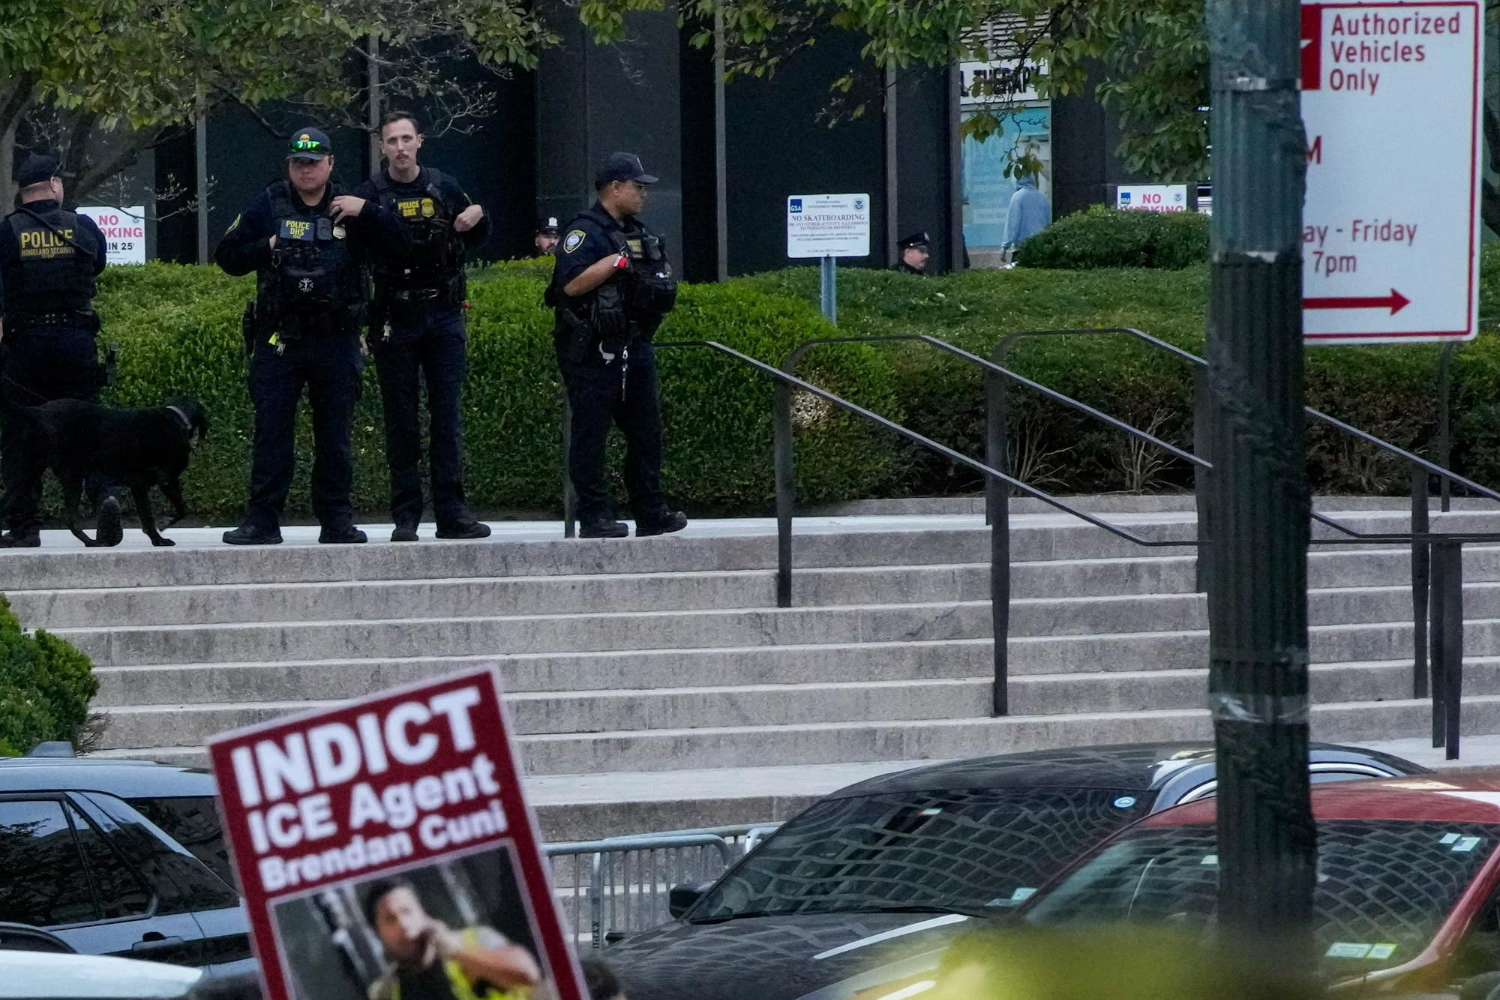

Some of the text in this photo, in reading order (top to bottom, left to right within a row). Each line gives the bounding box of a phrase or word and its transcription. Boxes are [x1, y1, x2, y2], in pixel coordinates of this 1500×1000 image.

[1331, 12, 1460, 36] Authorized
[1330, 40, 1426, 63] Vehicles
[1329, 68, 1380, 95] Only
[1142, 194, 1161, 204] NO
[99, 215, 119, 226] NO
[285, 220, 310, 230] POLICE
[1351, 218, 1418, 247] Friday
[21, 229, 73, 248] POLICE
[1313, 251, 1358, 278] 7pm
[230, 685, 481, 809] INDICT
[247, 752, 500, 855] ICE Agent
[257, 798, 509, 893] Brendan Cuni
